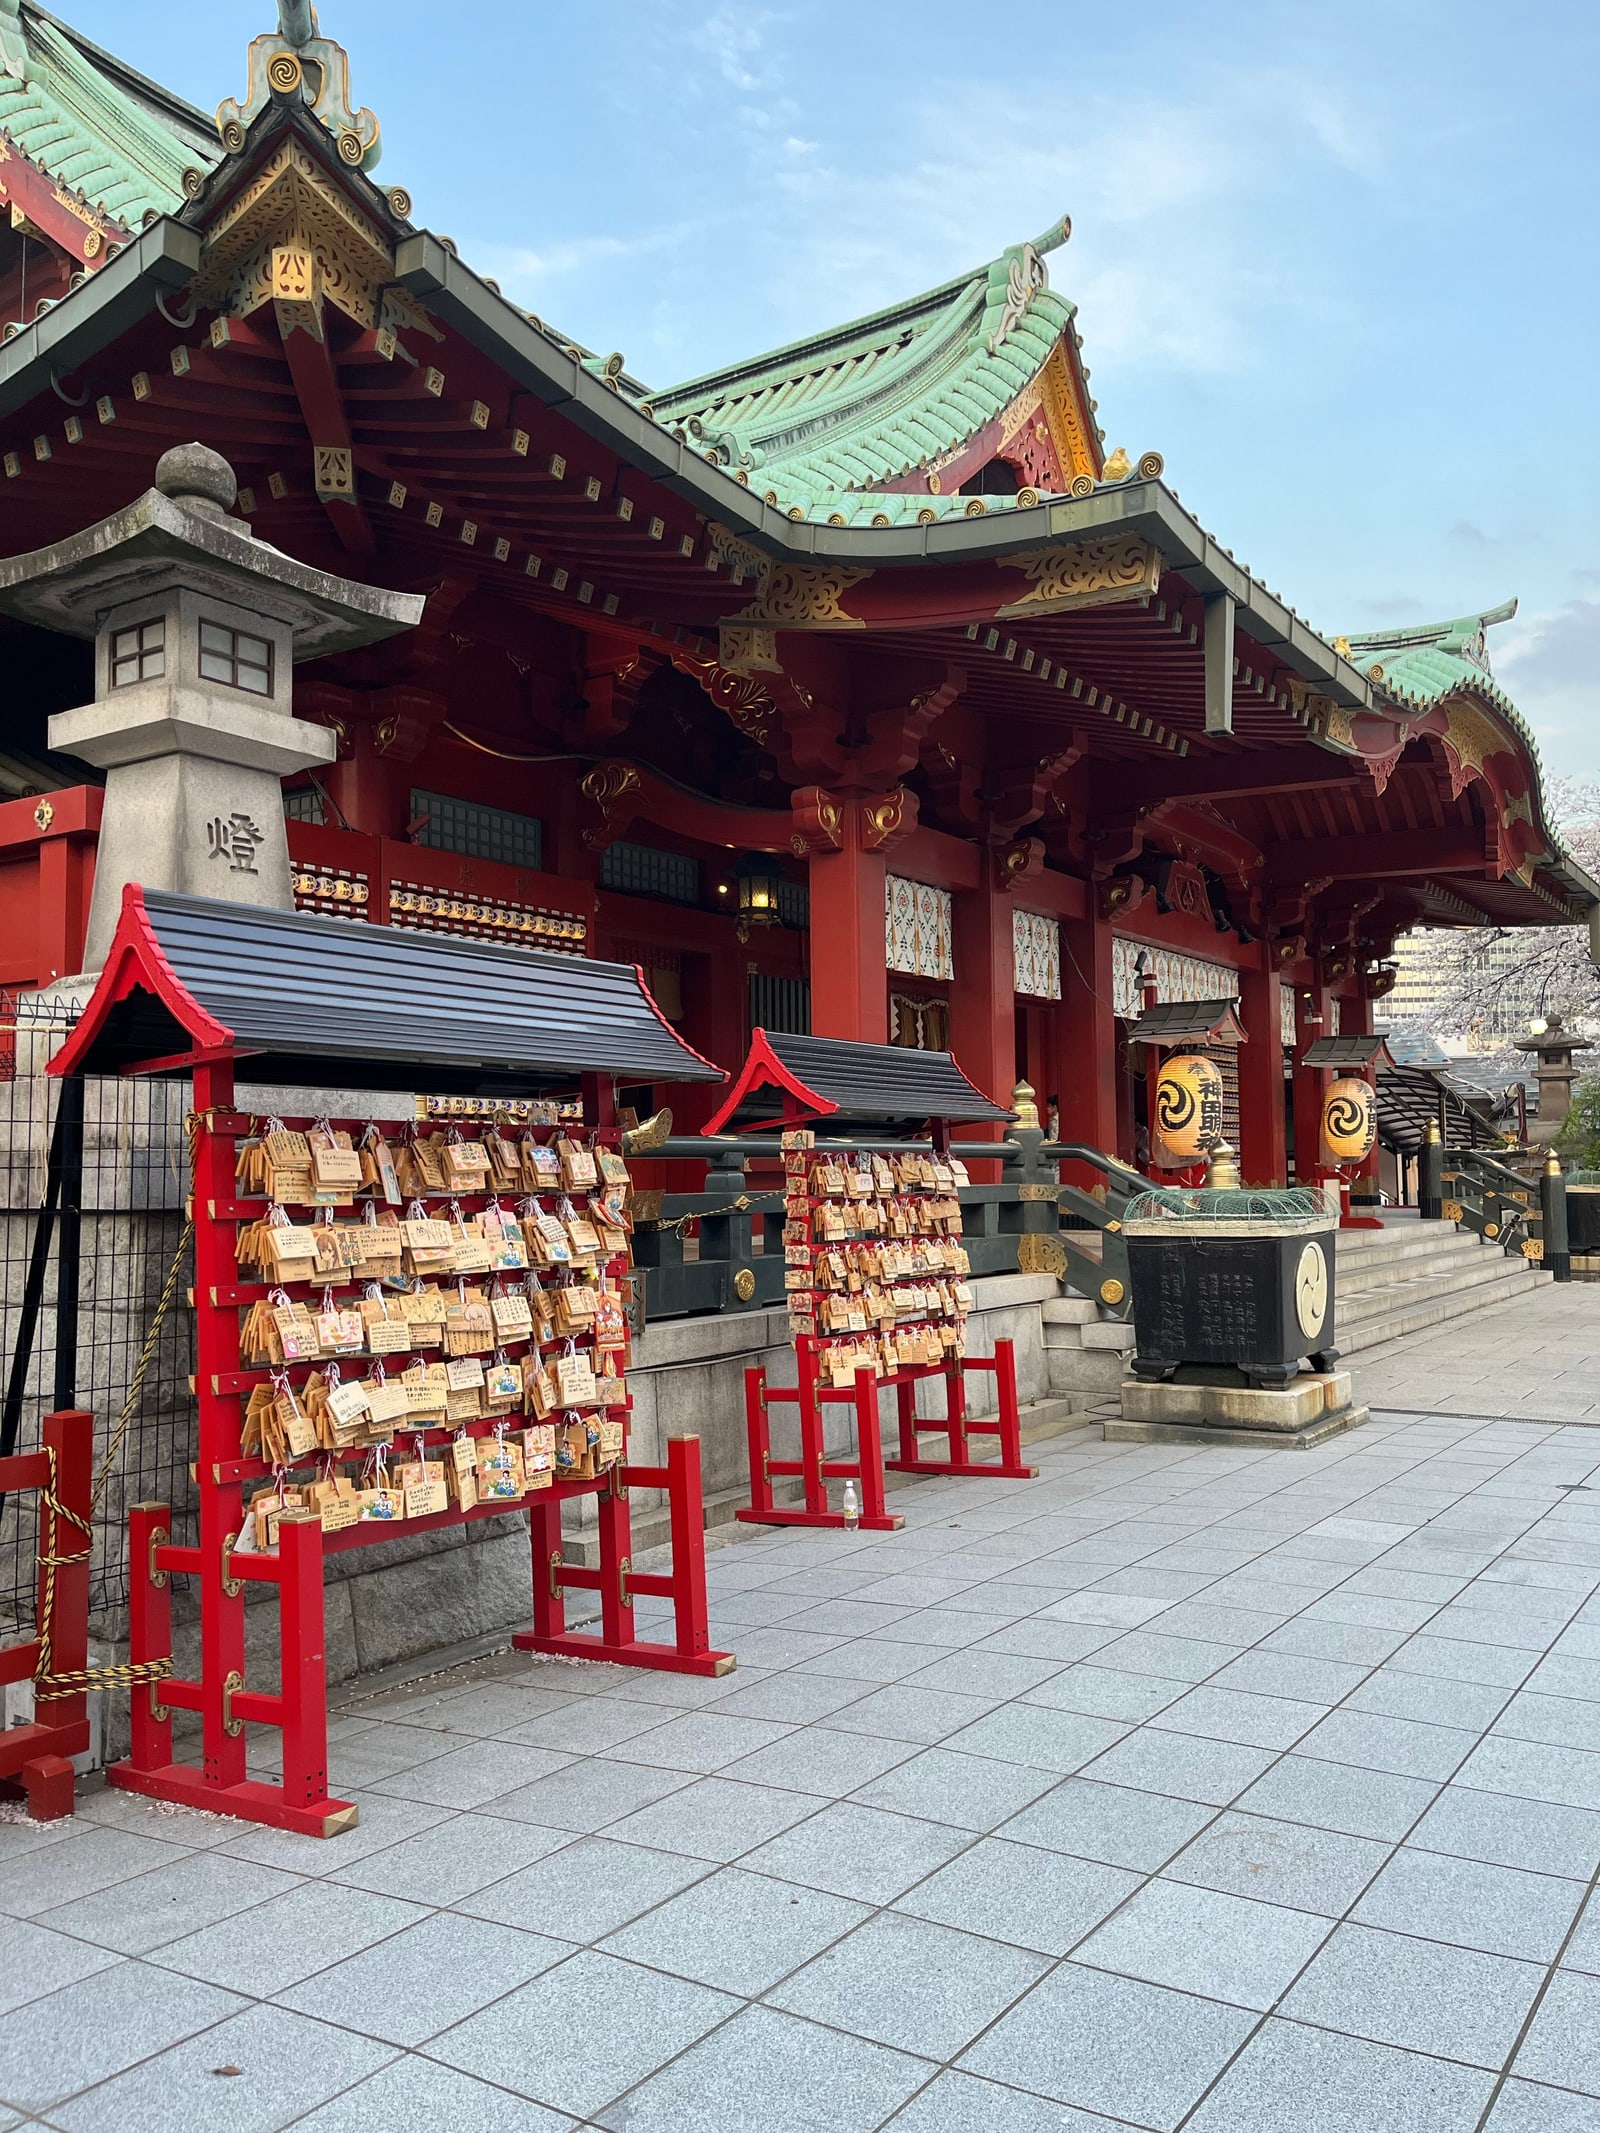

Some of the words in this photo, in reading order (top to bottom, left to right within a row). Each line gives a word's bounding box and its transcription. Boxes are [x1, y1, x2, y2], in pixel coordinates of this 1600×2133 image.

[207, 812, 265, 876] 燈
[1192, 1078, 1221, 1152] 神田明神
